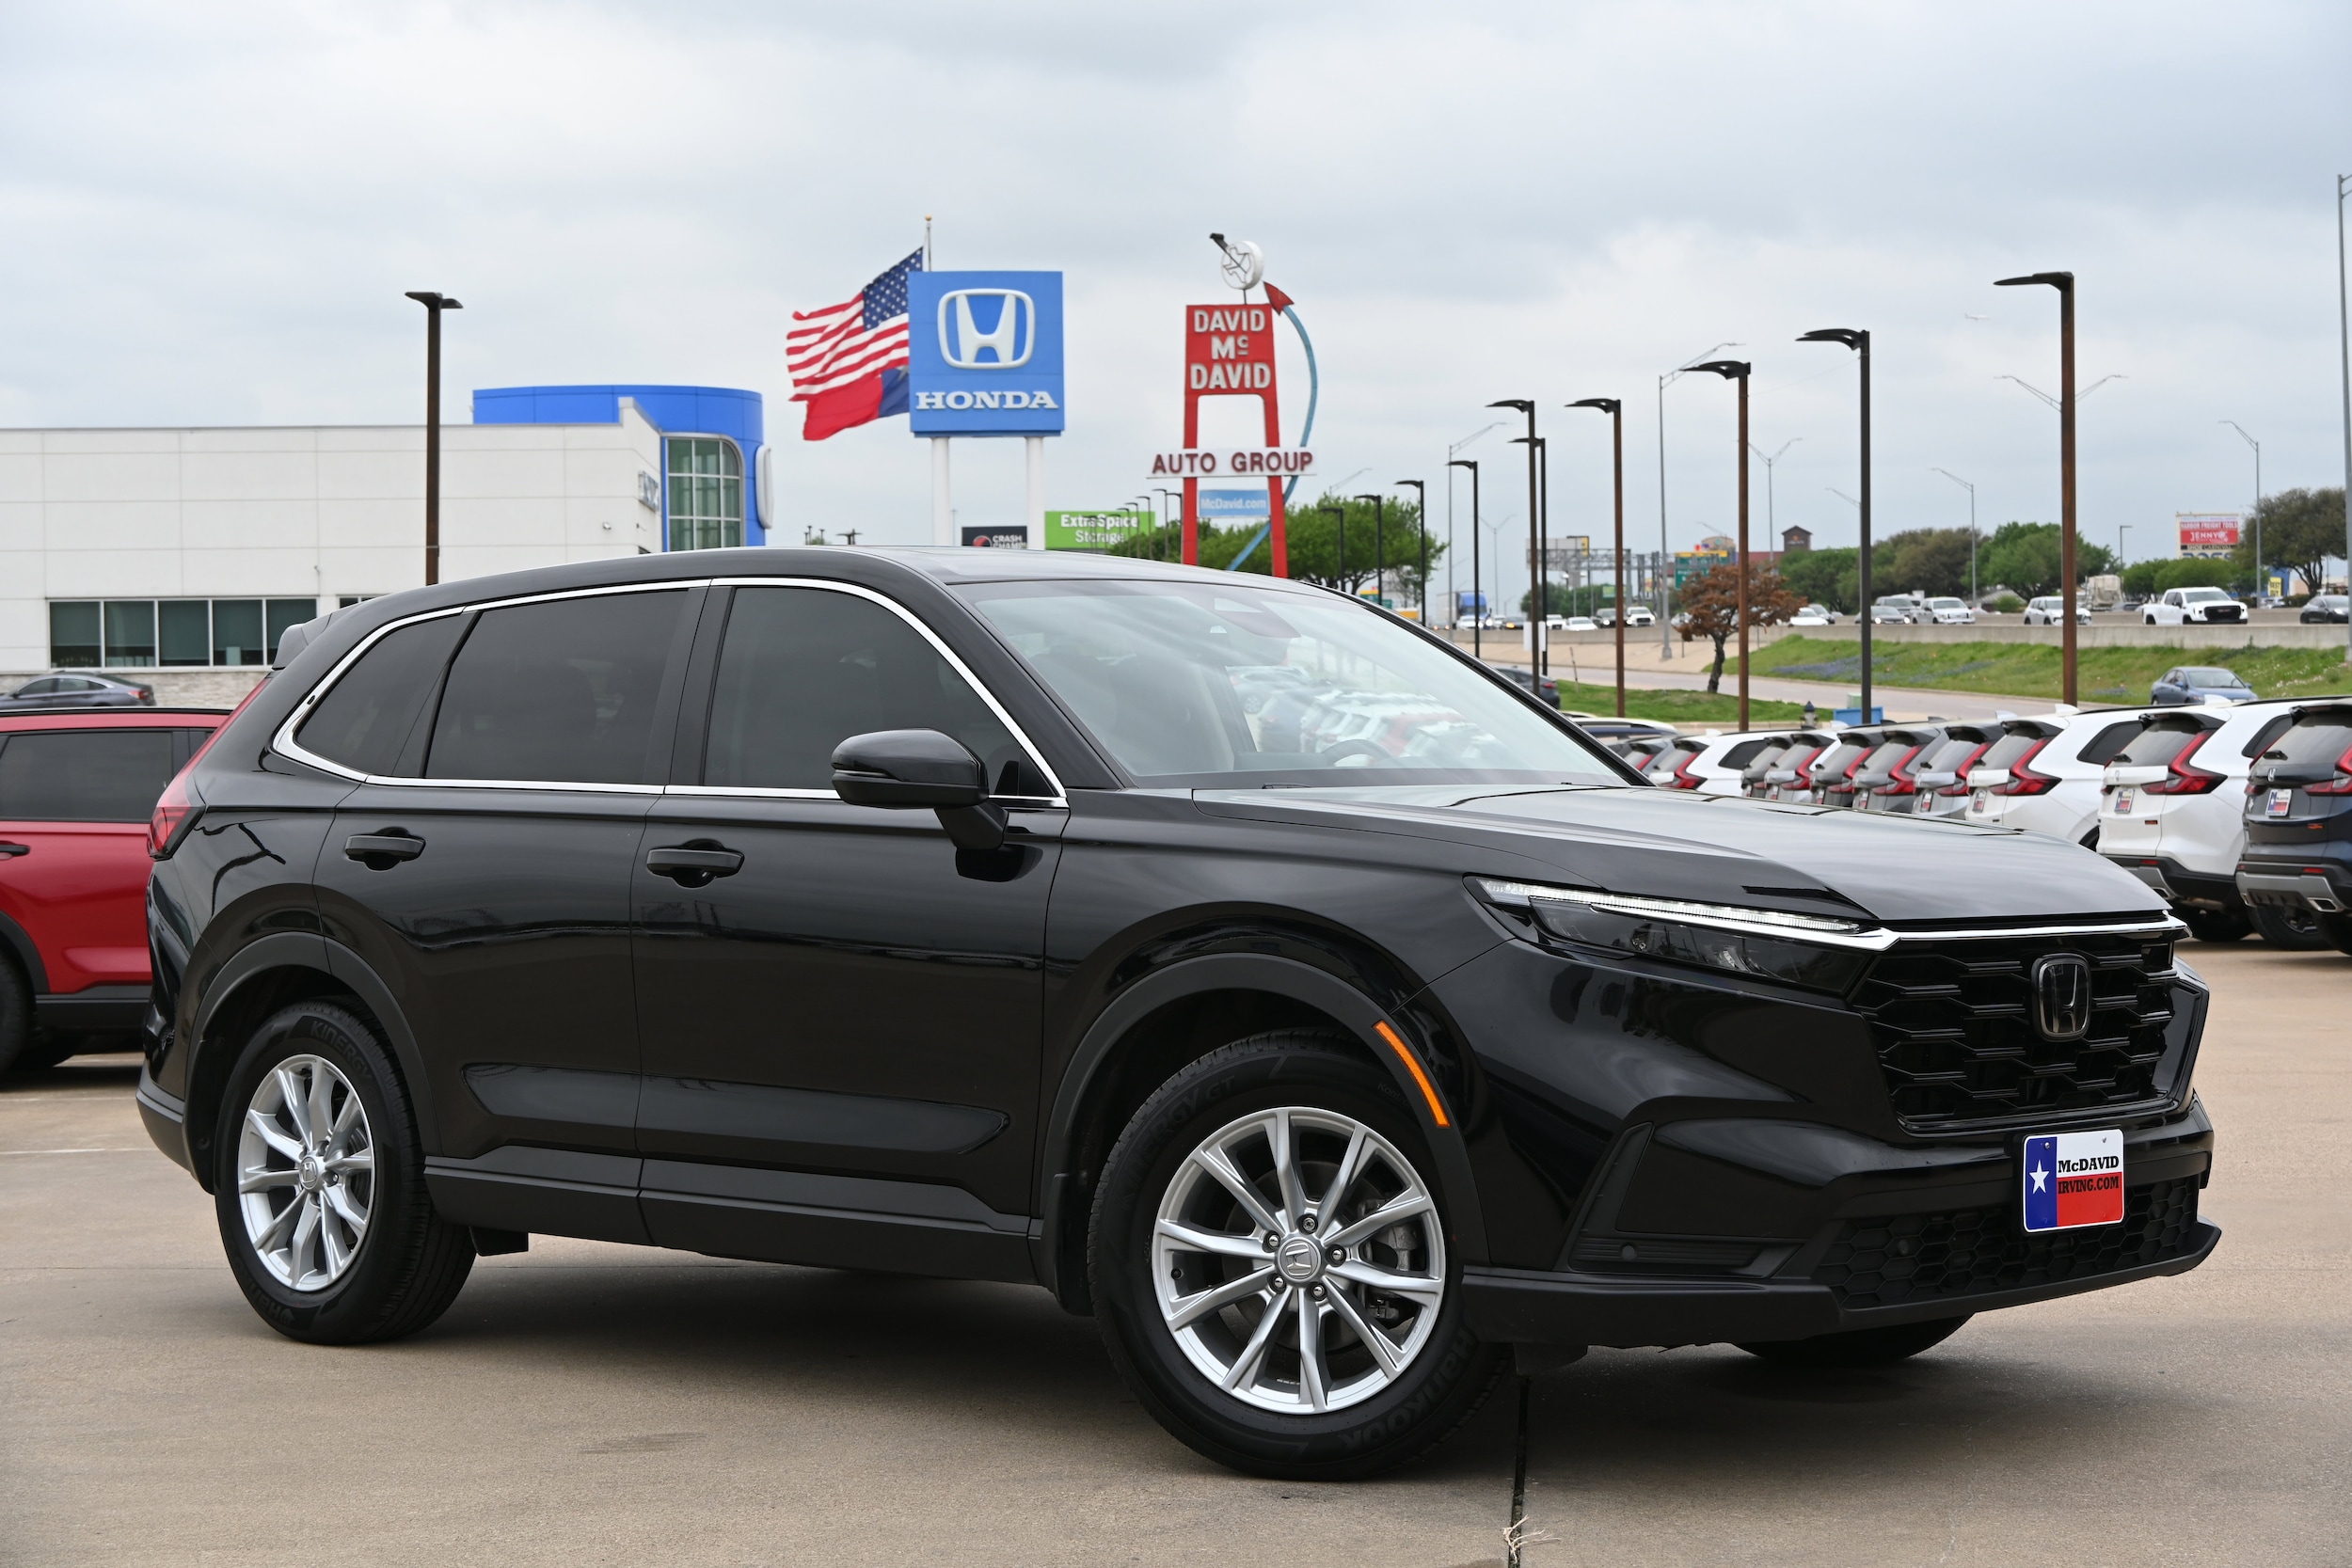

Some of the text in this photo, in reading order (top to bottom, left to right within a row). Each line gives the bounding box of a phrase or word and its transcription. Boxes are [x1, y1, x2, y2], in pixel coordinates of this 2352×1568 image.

[1194, 309, 1265, 333] DAVID
[1190, 362, 1271, 389] DAVID
[915, 390, 1059, 410] HONDA
[1152, 451, 1312, 474] AUTO GROUP
[1200, 498, 1266, 509] McDavid.com
[1075, 530, 1124, 545] Storage
[310, 1020, 373, 1080] KINERGY
[1376, 1082, 1410, 1107] Kontro
[2058, 1155, 2120, 1173] McDAVID
[2058, 1176, 2120, 1195] IRVING.COM
[1338, 1326, 1477, 1449] Hankook
